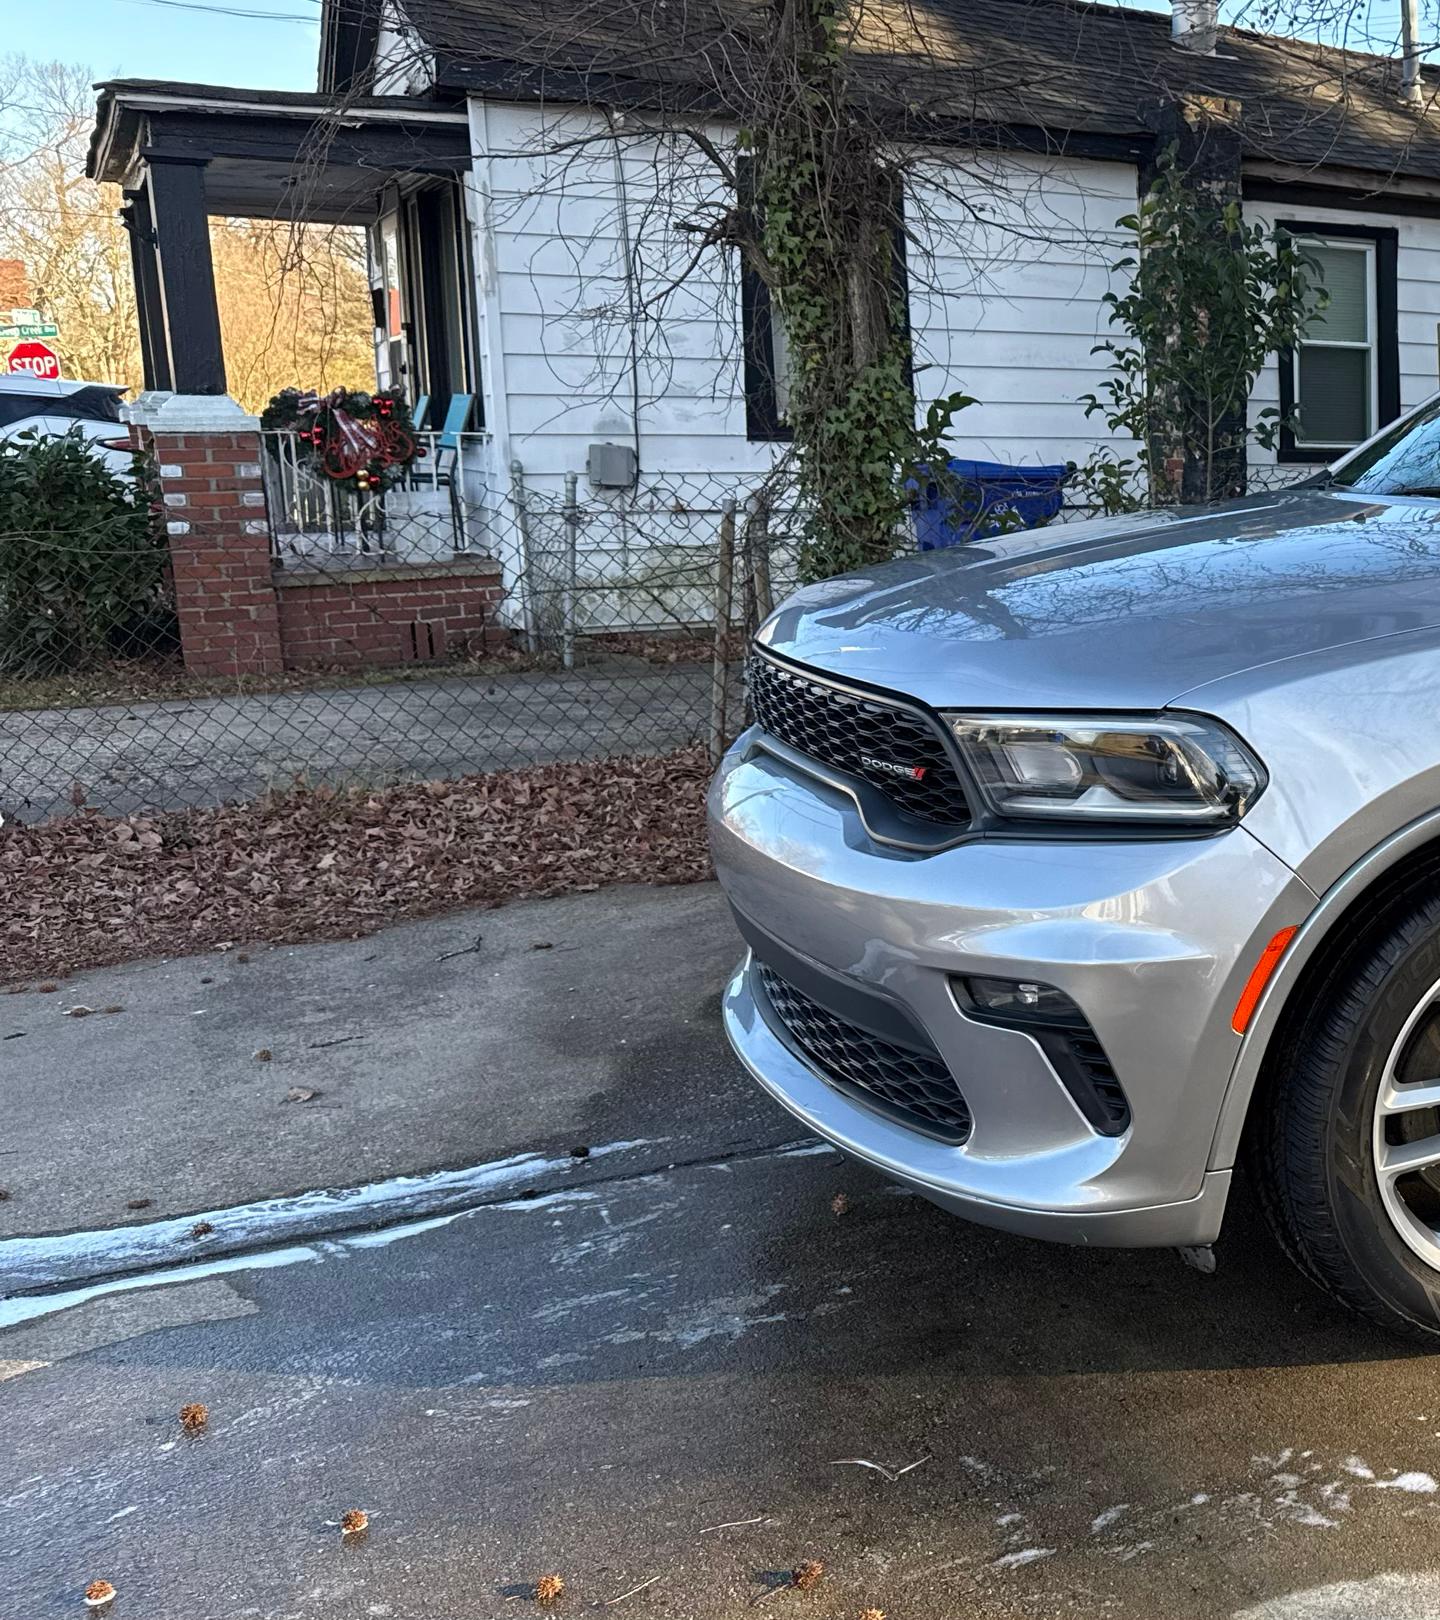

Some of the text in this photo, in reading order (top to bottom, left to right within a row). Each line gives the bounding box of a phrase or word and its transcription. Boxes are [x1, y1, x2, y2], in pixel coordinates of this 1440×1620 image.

[21, 326, 43, 336] Creek
[11, 356, 56, 376] STOP
[861, 756, 916, 778] DODGE
